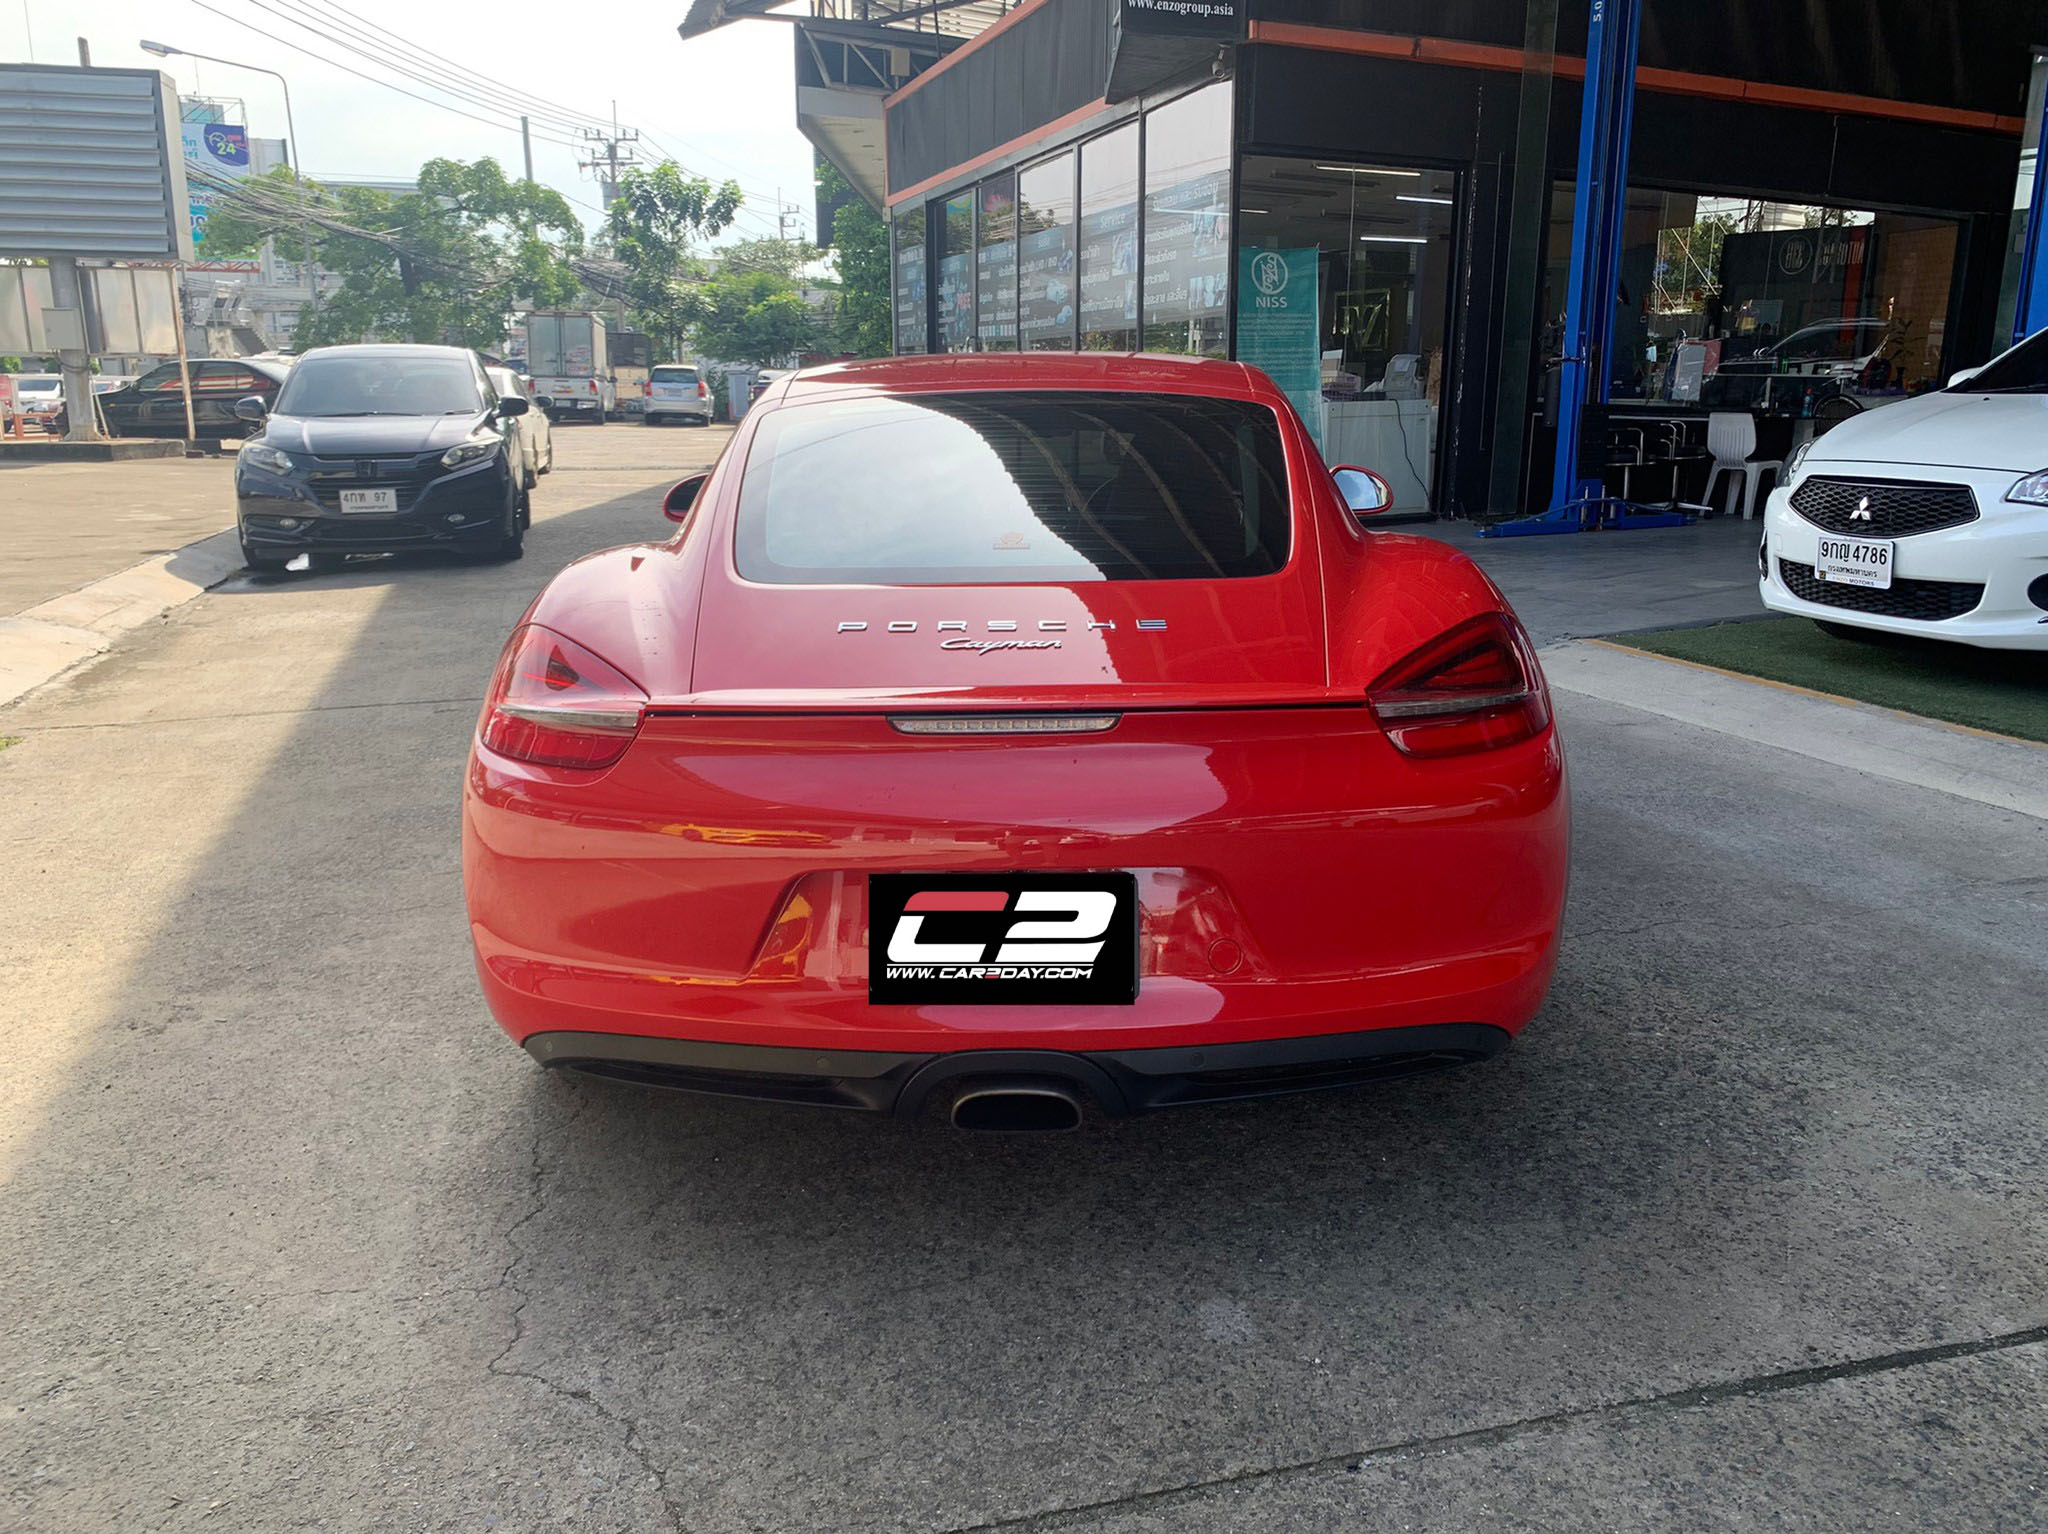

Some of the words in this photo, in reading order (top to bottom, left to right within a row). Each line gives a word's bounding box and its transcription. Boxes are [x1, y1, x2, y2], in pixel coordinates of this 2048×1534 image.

[1127, 0, 1234, 17] www.enzogroup.asia
[1256, 297, 1288, 308] NISS
[1821, 541, 1850, 562] 9กญ
[1853, 544, 1888, 565] 4786
[837, 619, 1168, 633] PORSCHE
[940, 637, 1062, 655] Cayman
